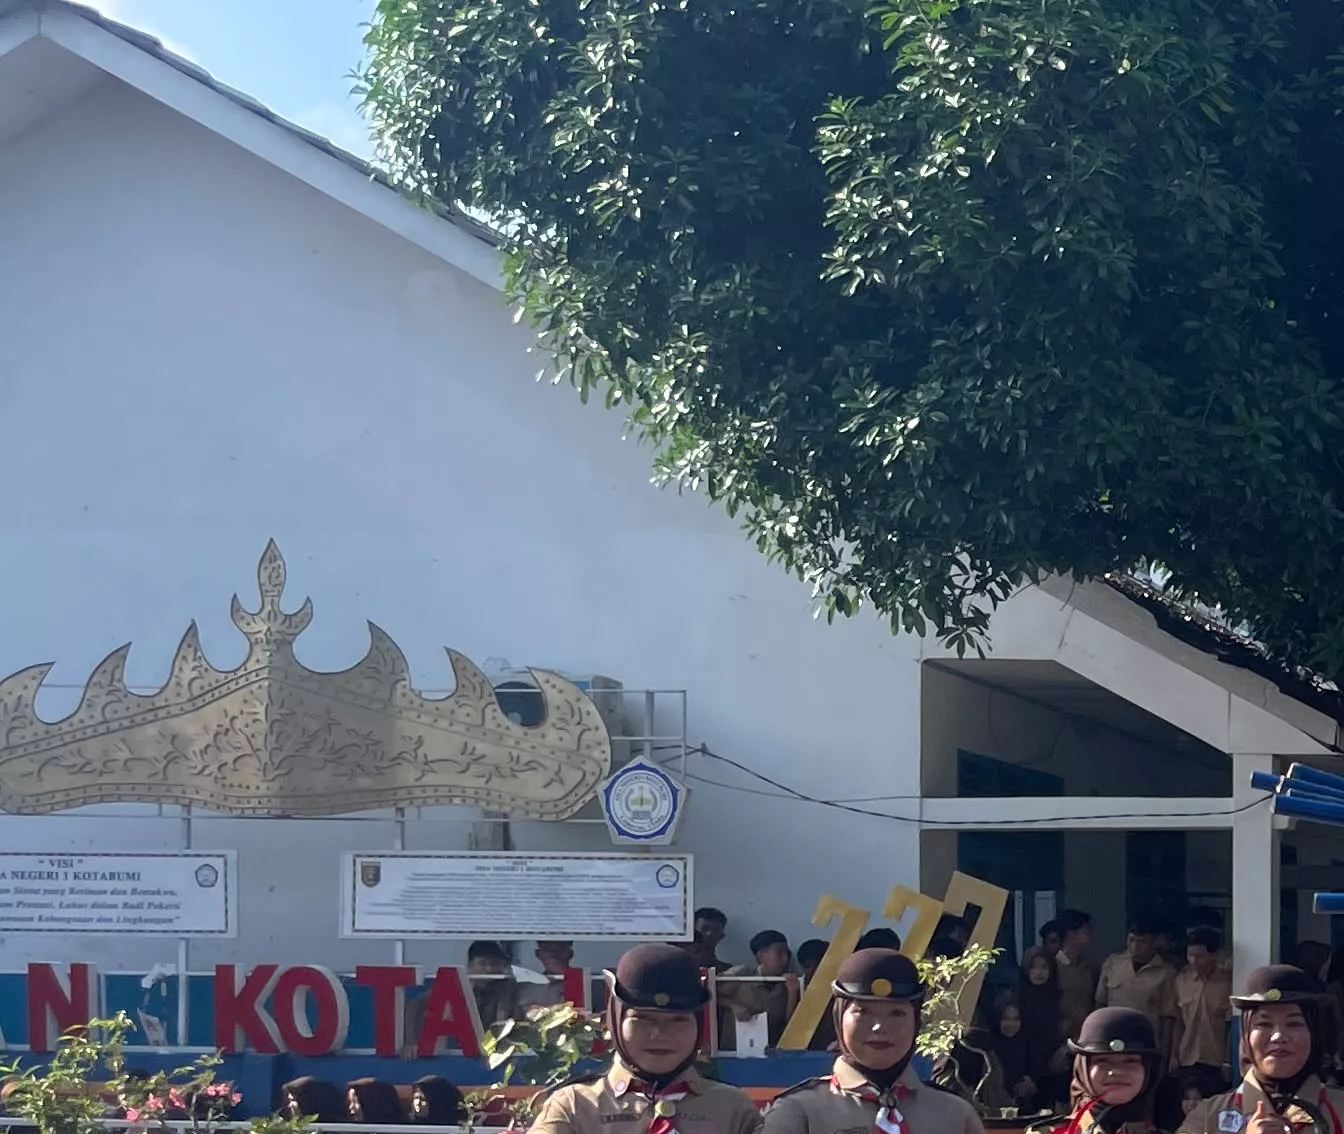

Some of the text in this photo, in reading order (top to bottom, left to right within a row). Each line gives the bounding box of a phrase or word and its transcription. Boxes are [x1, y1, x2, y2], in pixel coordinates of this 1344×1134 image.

[11, 871, 59, 881] NEGERI
[73, 871, 141, 881] KOTABUMI
[213, 963, 482, 1057] KOTA
